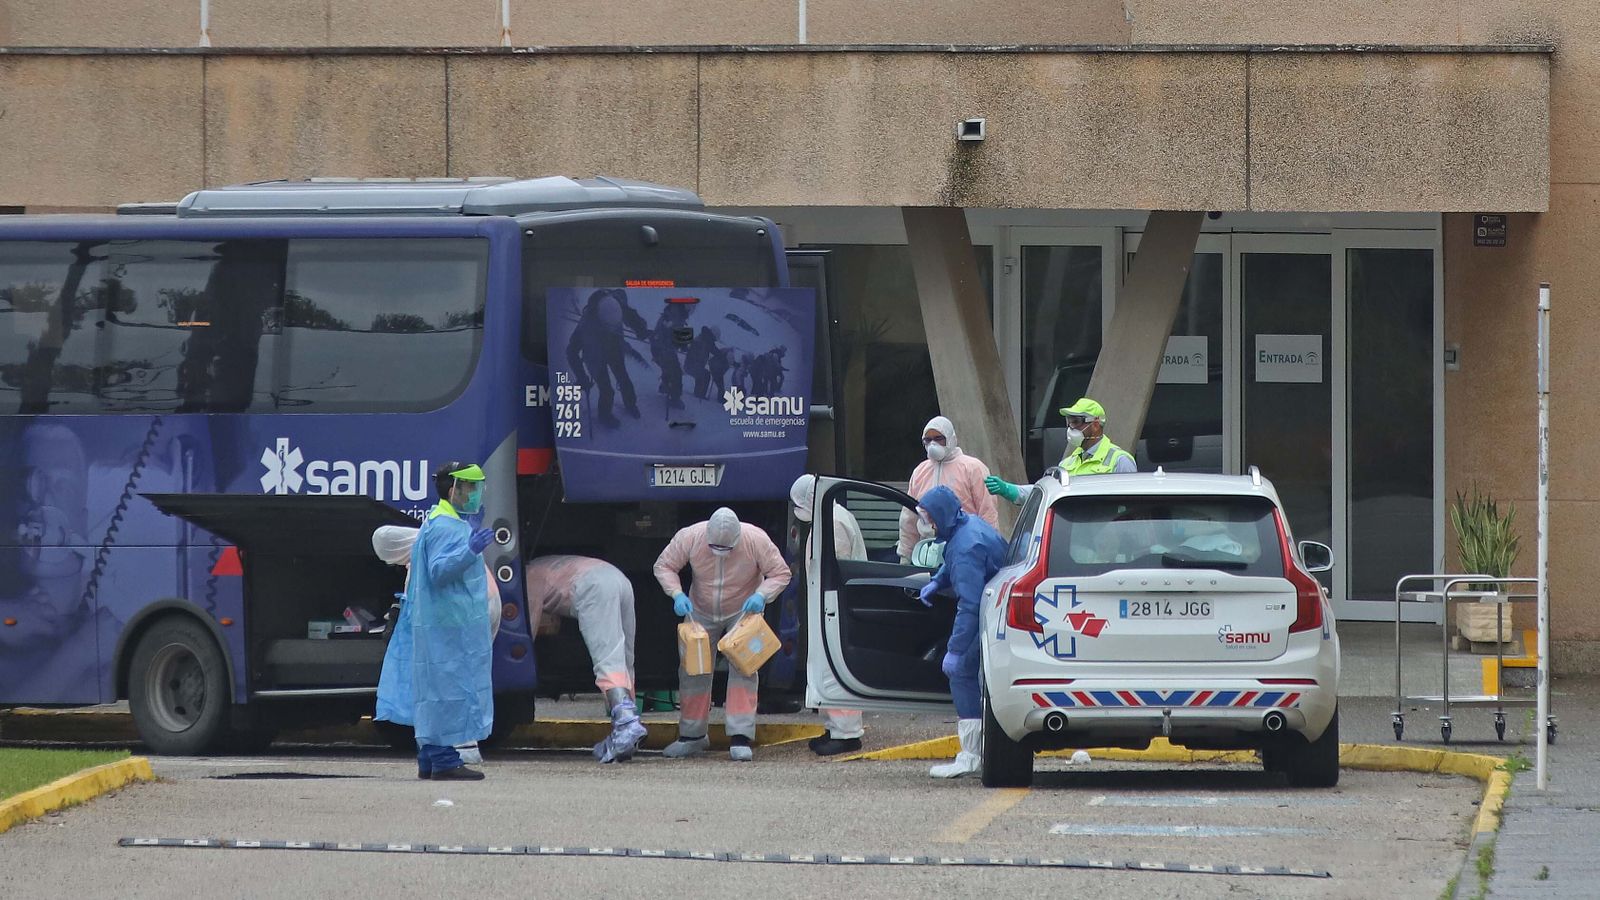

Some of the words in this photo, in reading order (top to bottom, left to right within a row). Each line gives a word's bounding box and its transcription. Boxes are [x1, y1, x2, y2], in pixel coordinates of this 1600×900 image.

[1259, 350, 1303, 364] ENTRADA
[556, 371, 571, 383] Tel.
[556, 385, 581, 401] 955
[556, 403, 580, 419] 761
[745, 396, 803, 415] samu
[556, 421, 581, 437] 792
[730, 416, 754, 425] escuela
[755, 416, 764, 426] de
[765, 416, 805, 427] emergencias
[305, 459, 428, 501] samu
[660, 469, 685, 484] 1214
[690, 469, 711, 484] GJL
[1131, 602, 1173, 617] 2814
[1179, 602, 1211, 617] JGG
[1225, 632, 1270, 643] samu
